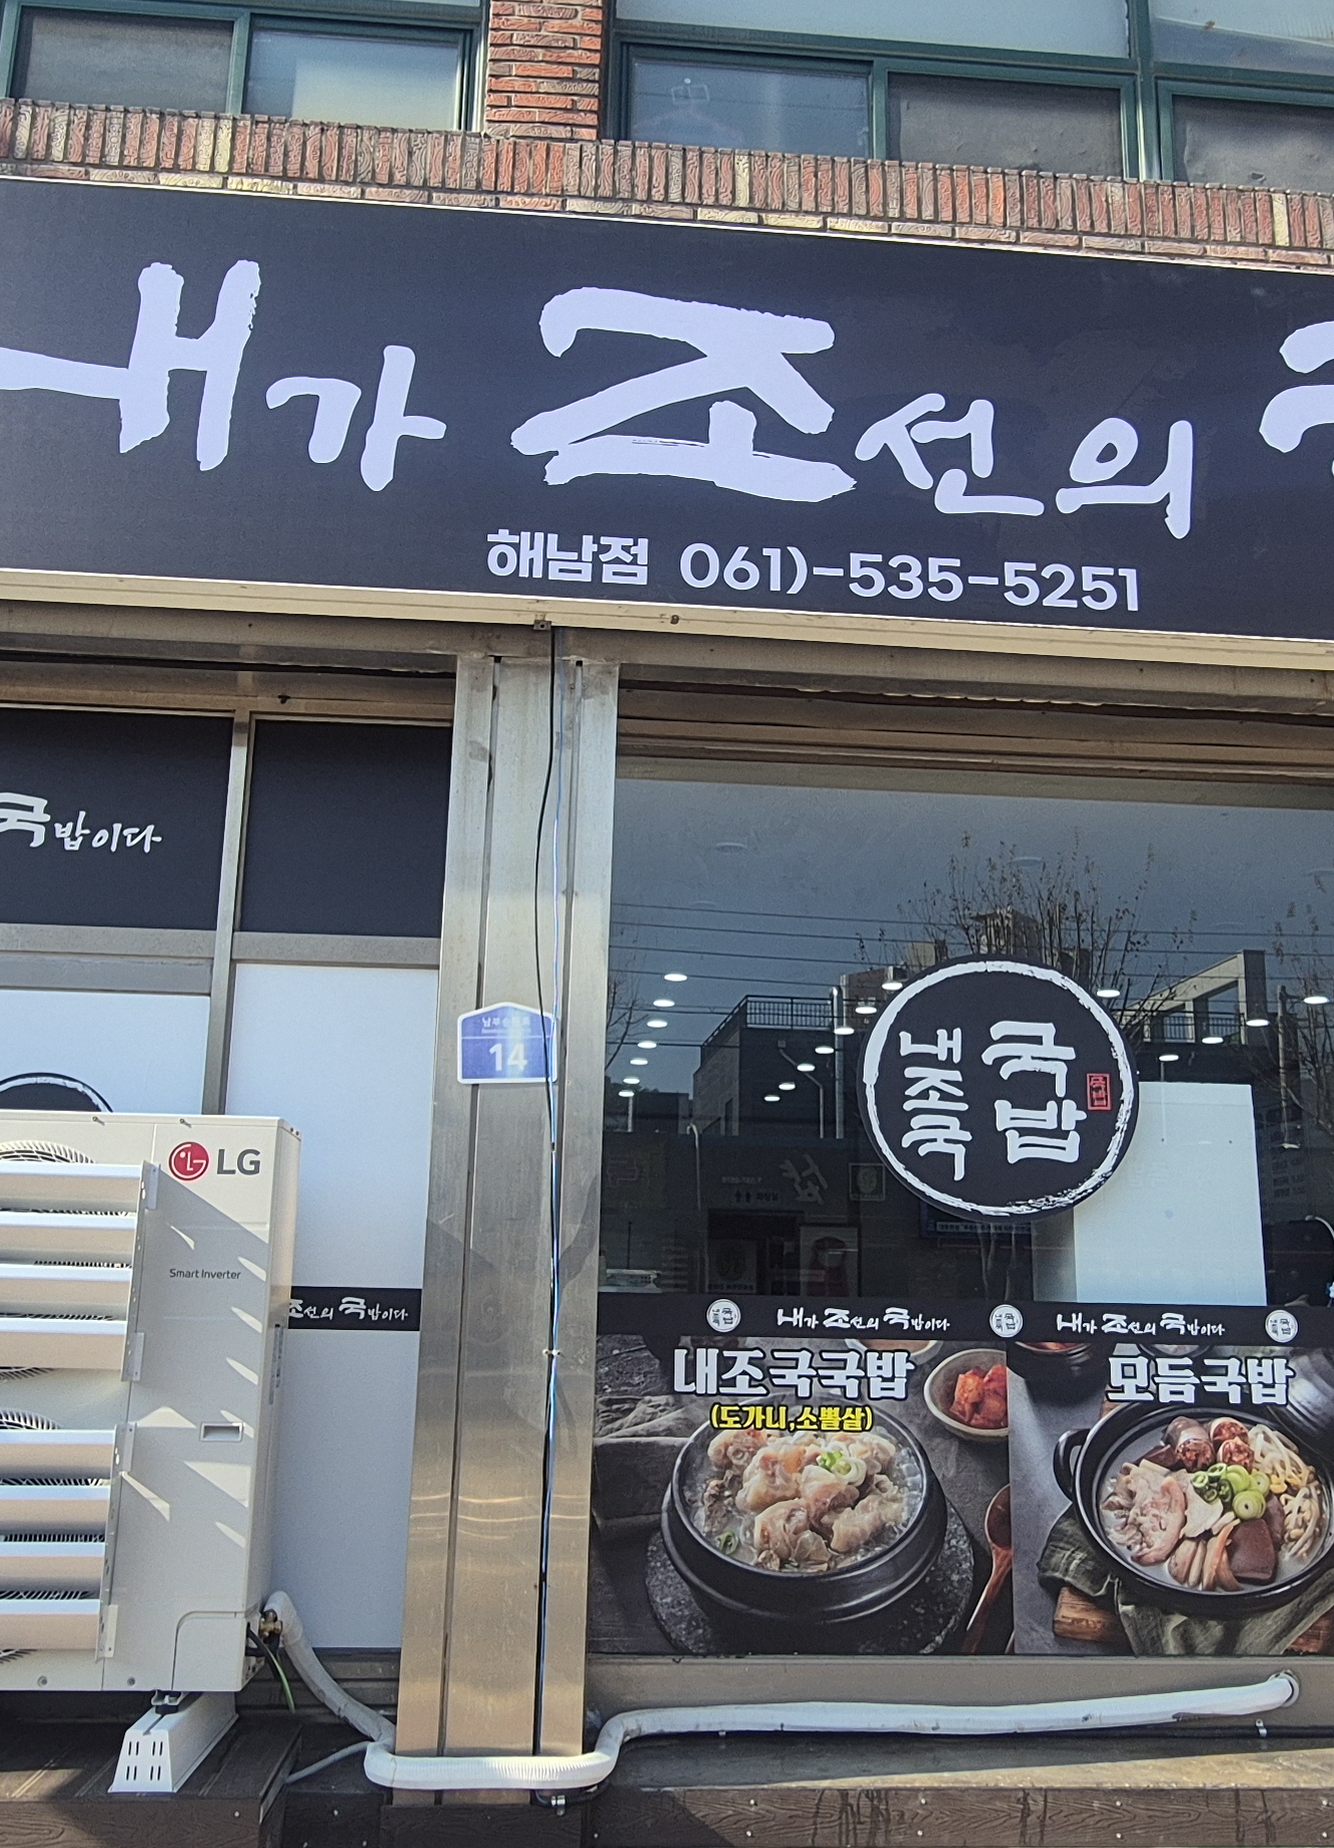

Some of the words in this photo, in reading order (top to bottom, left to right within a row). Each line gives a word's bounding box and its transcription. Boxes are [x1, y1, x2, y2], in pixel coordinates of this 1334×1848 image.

[509, 287, 1192, 539] 조선의
[487, 528, 648, 586] 해남점
[679, 542, 1138, 612] 061)-535-5251
[489, 1043, 528, 1071] 14
[899, 1028, 972, 1181] 내조국
[981, 1020, 1087, 1164] 국밥
[216, 1148, 262, 1176] LG
[169, 1268, 200, 1279] Smart
[201, 1268, 242, 1280] Inverter
[338, 1296, 409, 1321] 국밥이다
[776, 1307, 819, 1330] 내가
[822, 1307, 879, 1331] 조선의
[883, 1306, 950, 1331] 국밥이다
[1056, 1312, 1098, 1335] 내가
[1101, 1313, 1156, 1336] 조선의
[1160, 1312, 1225, 1336] 국밥이다
[673, 1347, 915, 1399] 내조국국밥
[1107, 1355, 1295, 1405] 모듬국밥
